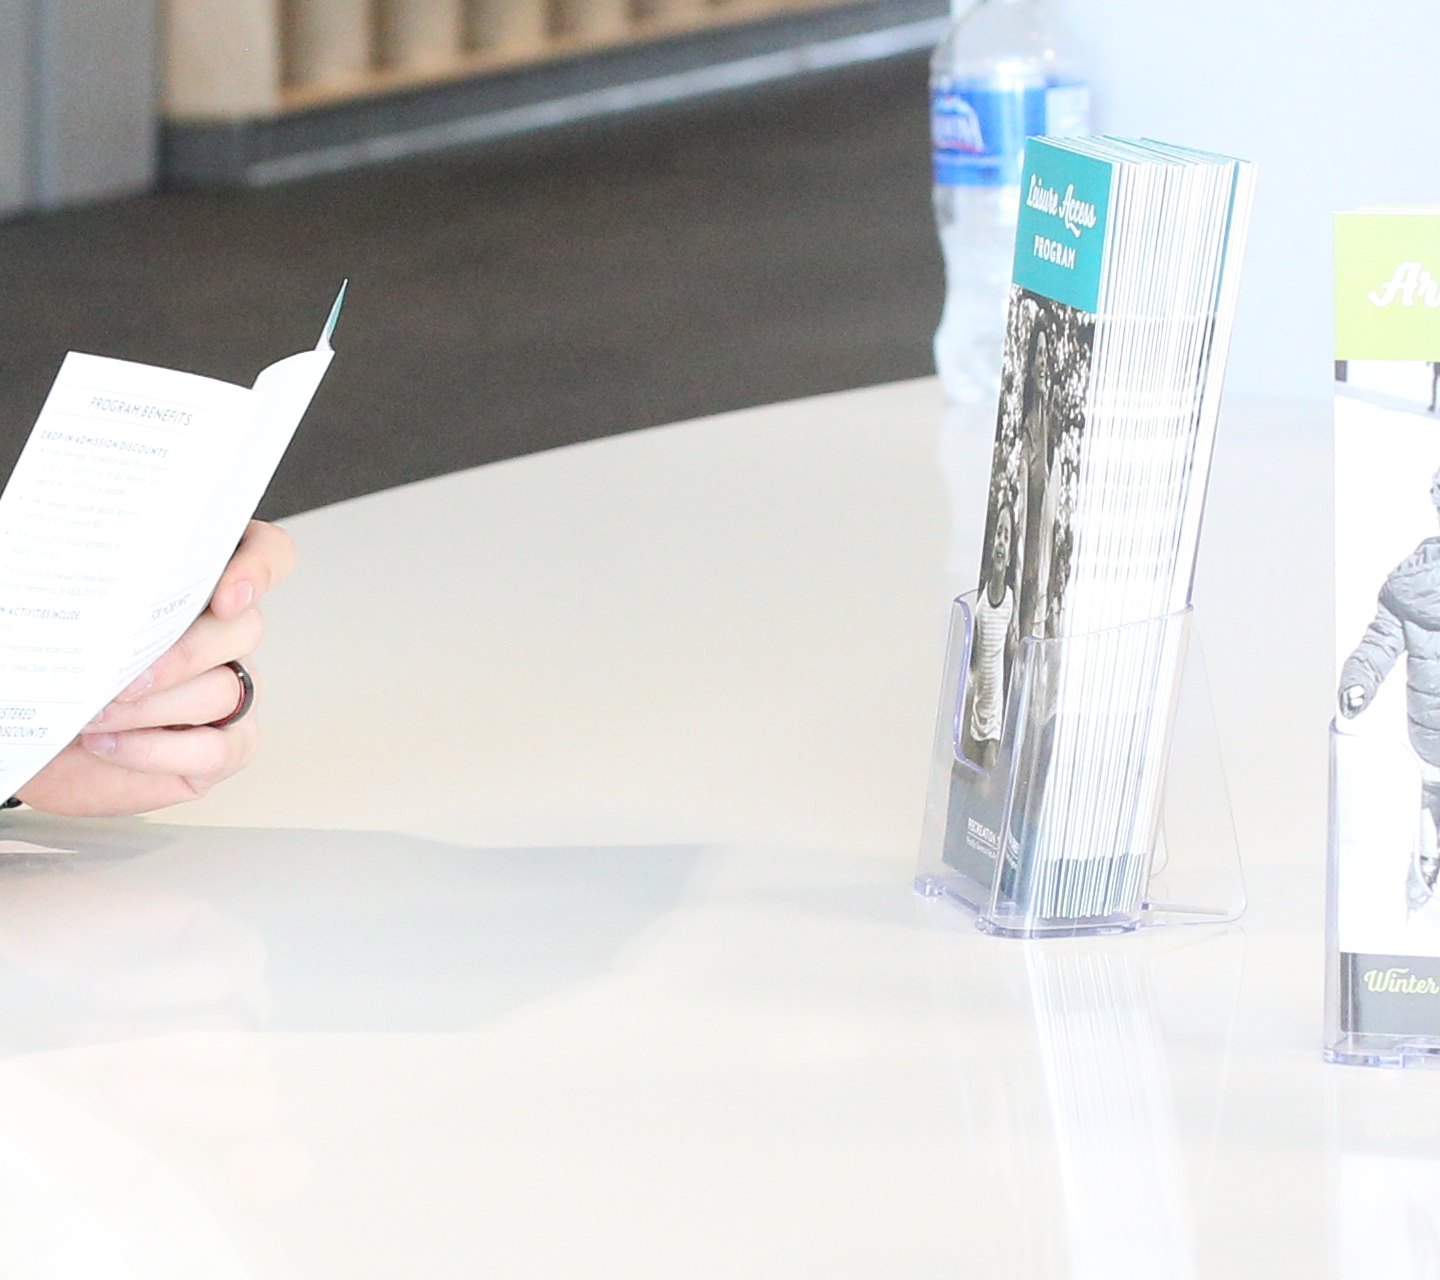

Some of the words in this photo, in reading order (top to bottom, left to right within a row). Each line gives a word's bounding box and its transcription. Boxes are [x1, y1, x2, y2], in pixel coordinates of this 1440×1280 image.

[1026, 173, 1059, 217] Leisure
[1058, 183, 1097, 238] Access
[1032, 234, 1077, 270] PROGRAM
[87, 396, 141, 417] PROGRAM
[141, 405, 193, 427] BENEFITS
[119, 439, 169, 459] DISCOUNTS
[6, 606, 52, 620] ACTIVITIES
[1363, 967, 1440, 995] Winter
